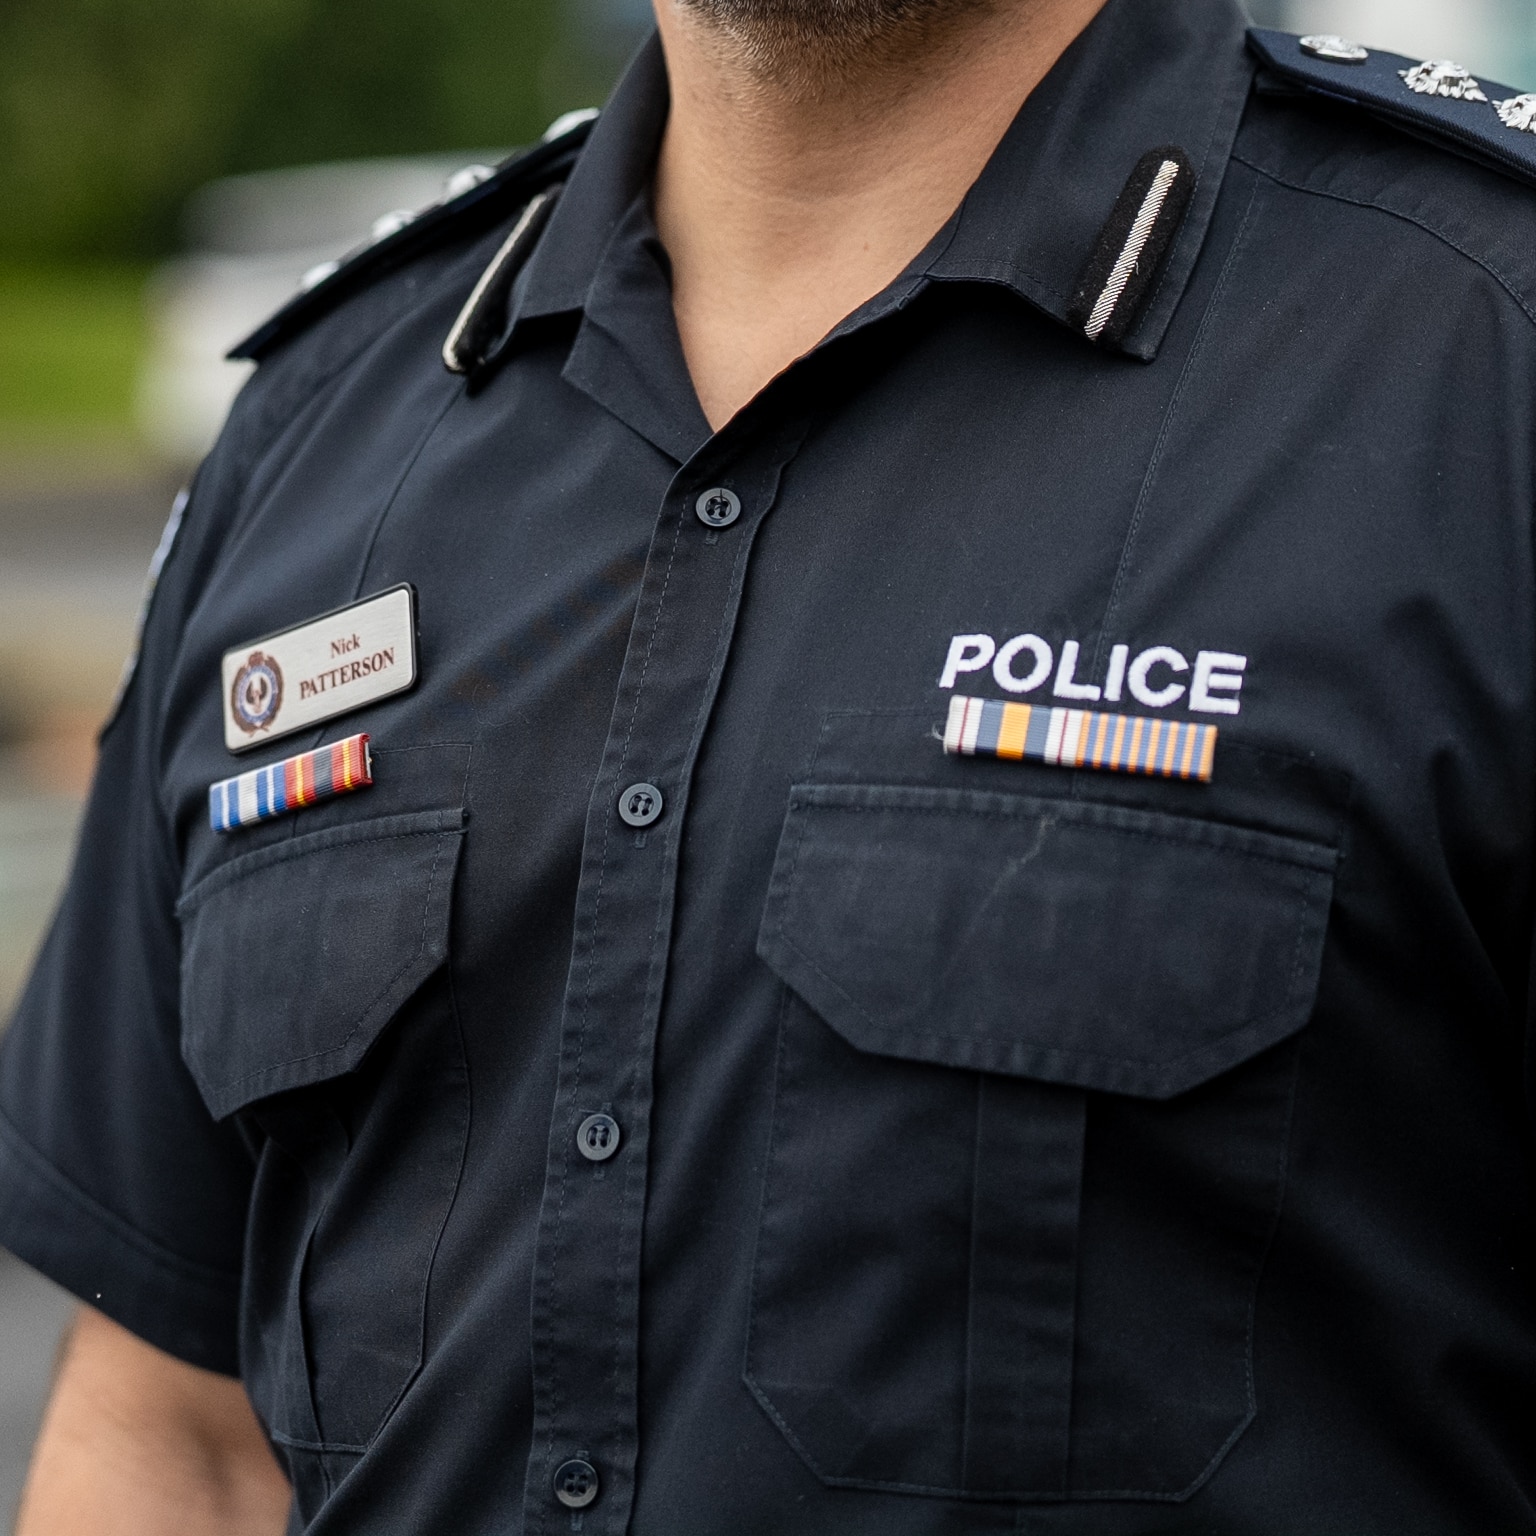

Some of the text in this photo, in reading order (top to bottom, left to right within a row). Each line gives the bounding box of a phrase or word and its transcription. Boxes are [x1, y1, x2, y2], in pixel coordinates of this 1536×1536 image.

[330, 634, 361, 658] Nick
[298, 647, 395, 699] PATTERSON
[939, 634, 1247, 714] POLICE
